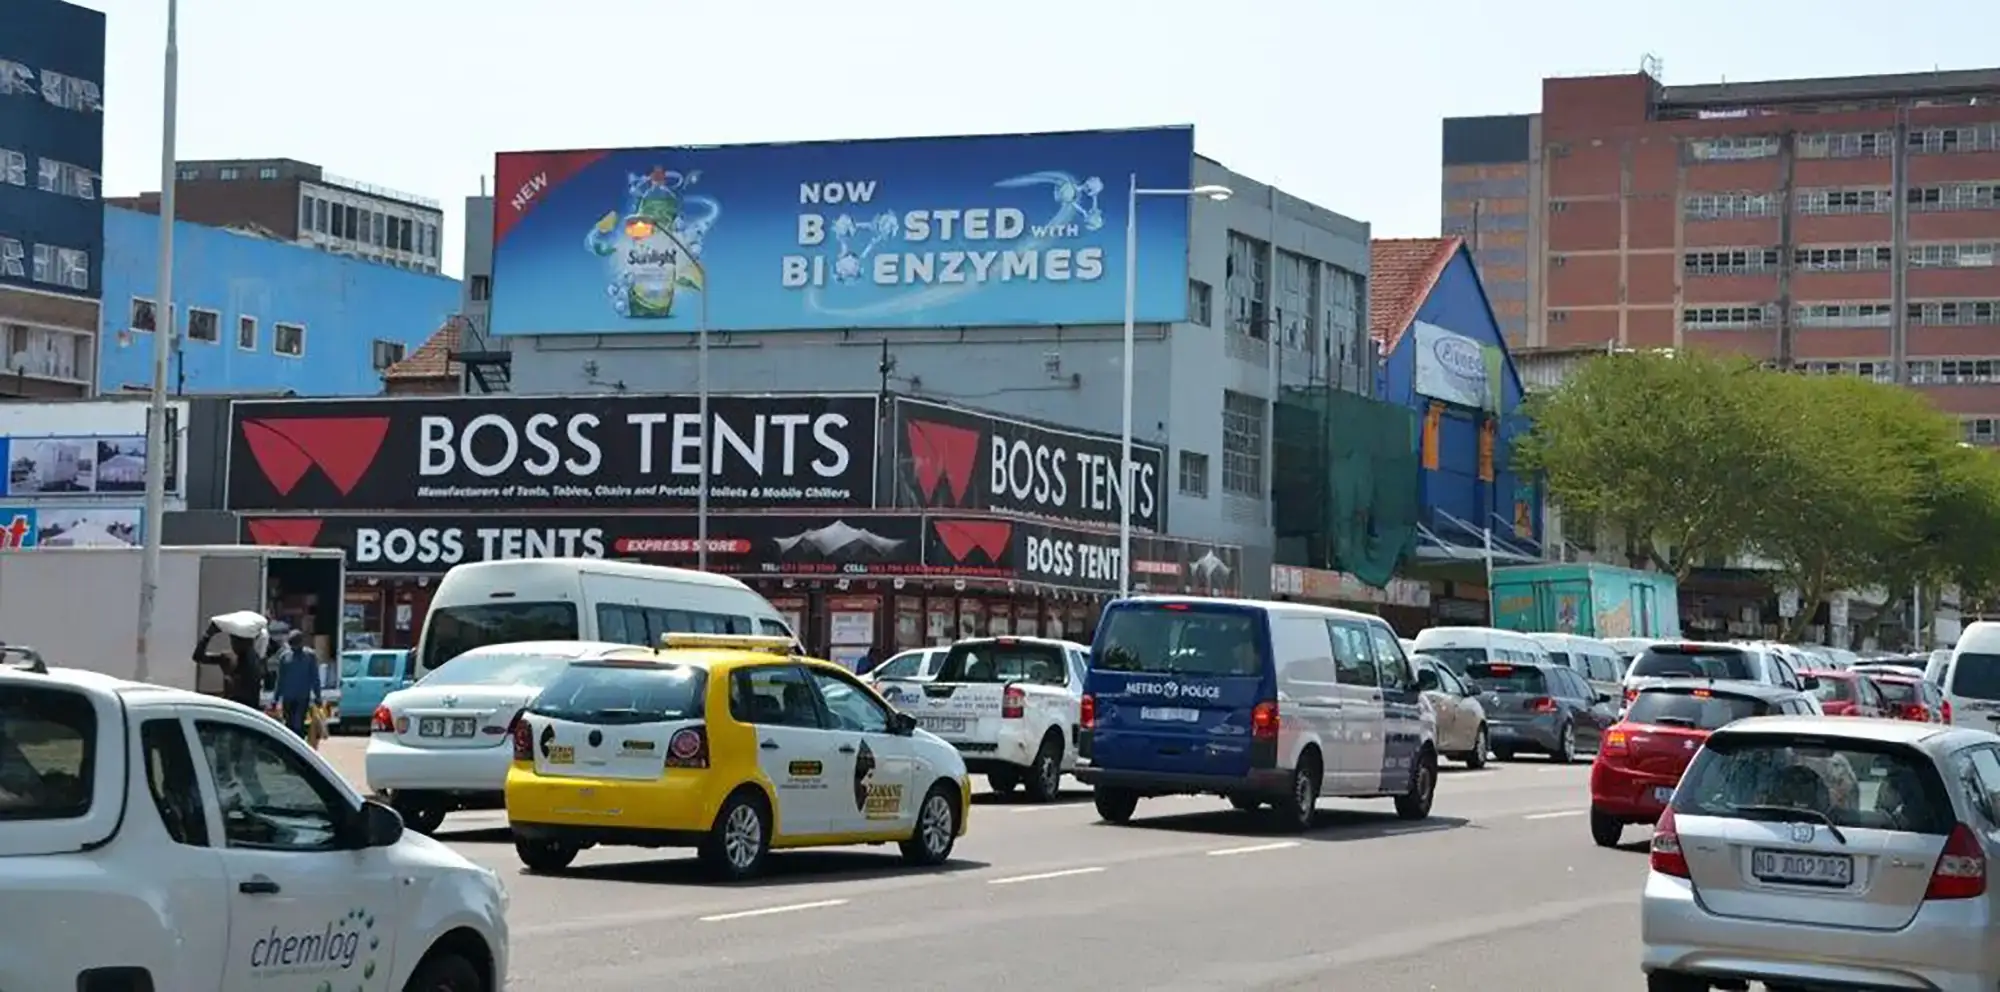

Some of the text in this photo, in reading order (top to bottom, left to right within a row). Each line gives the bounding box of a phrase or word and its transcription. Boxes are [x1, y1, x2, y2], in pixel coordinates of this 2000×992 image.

[511, 171, 548, 211] NEW
[800, 181, 876, 204] NOW
[1031, 223, 1080, 238] WITH
[627, 248, 676, 267] Sunlight
[420, 412, 850, 478] BOSS TENTS
[991, 434, 1067, 507] BOSS
[417, 486, 499, 498] Manufacturers
[502, 486, 514, 497] of
[595, 485, 631, 497] Chairs
[634, 485, 656, 496] and
[763, 487, 802, 498] Mobile
[805, 487, 850, 499] Chillers
[356, 528, 605, 564] BOSS TENTS
[626, 539, 738, 552] EXPRESS SORE
[1026, 535, 1074, 578] BOSS
[1126, 681, 1164, 695] METRO
[1181, 684, 1220, 699] POLICE
[251, 921, 360, 969] chemlog
